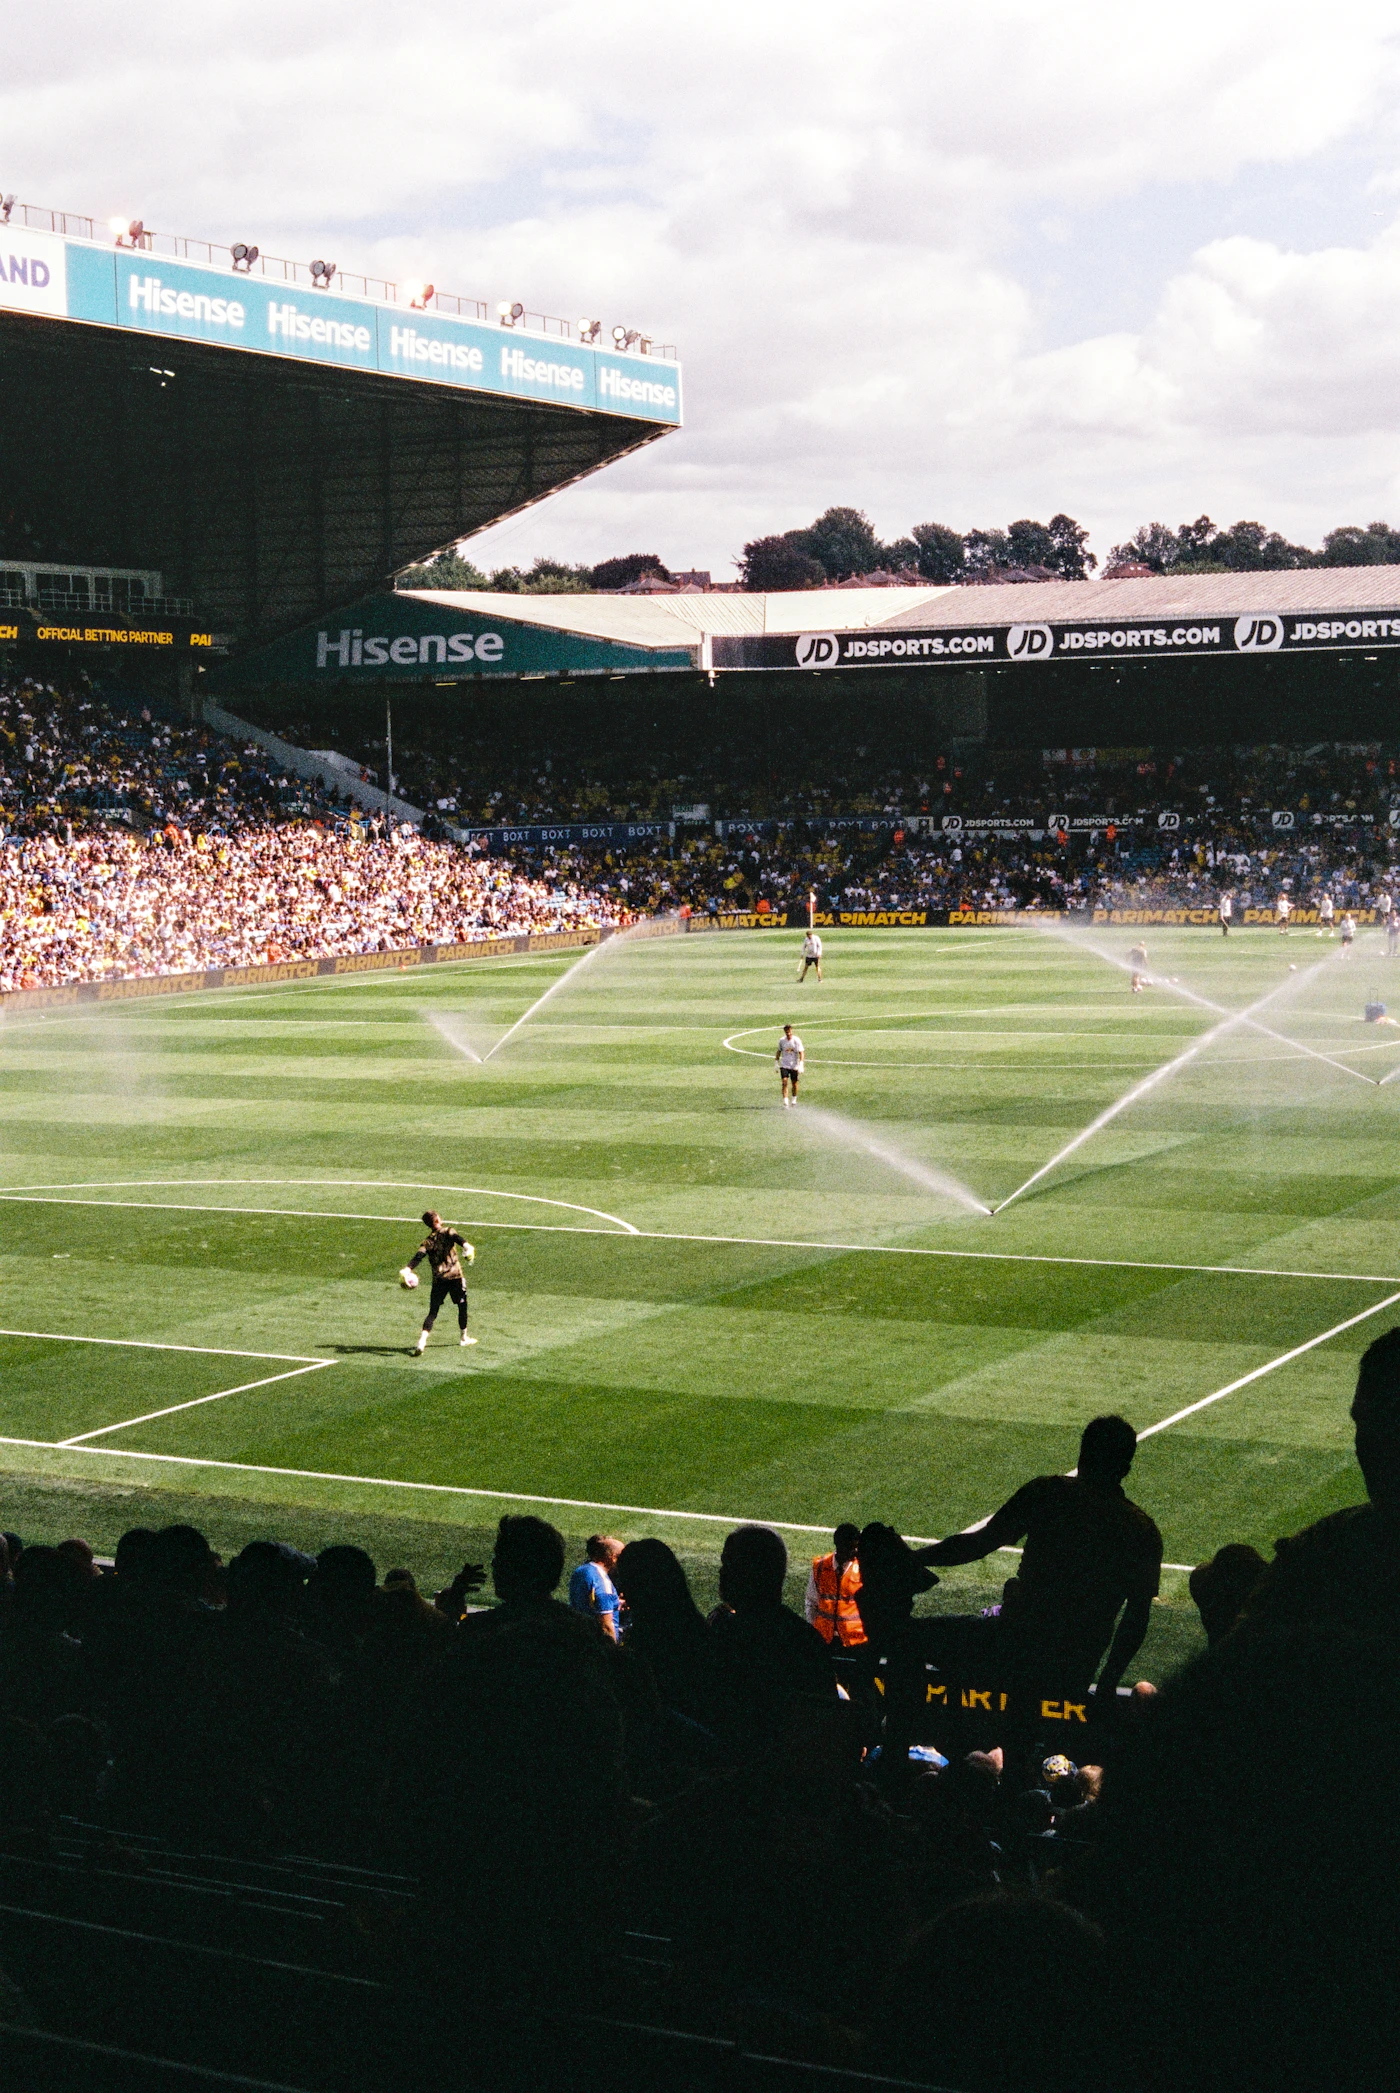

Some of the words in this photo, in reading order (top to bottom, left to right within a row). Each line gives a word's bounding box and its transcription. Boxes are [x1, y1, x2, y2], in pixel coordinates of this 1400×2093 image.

[129, 274, 244, 326] Hisense
[267, 300, 370, 351] Hisense
[390, 325, 483, 371] Hisense
[501, 347, 584, 390] Hisense
[600, 366, 676, 406] Hisense
[37, 626, 83, 642] OFFICIAL
[85, 628, 129, 643] BETTING
[129, 630, 174, 645] PARTNER
[1014, 629, 1048, 656] JD
[1059, 626, 1220, 650] JDSPORTS.COM
[1241, 620, 1277, 647] JD
[316, 629, 505, 668] Hisense
[802, 637, 833, 664] JD
[843, 636, 994, 658] JDSPORTS.COM
[542, 829, 571, 840] BOXT
[582, 827, 614, 839] BOXT
[628, 825, 662, 837] BOXT
[728, 822, 764, 833] BOXT
[964, 817, 1034, 828] JDSPORTS.COM
[503, 831, 529, 842] BOXT
[1092, 909, 1219, 923] PARIMATCH
[436, 941, 515, 962] PARIMATCH
[528, 930, 601, 952] PARIMATCH
[335, 950, 422, 974] PARIMATCH
[222, 962, 320, 987] PARIMATCH
[97, 973, 205, 1001] PARIMATCH
